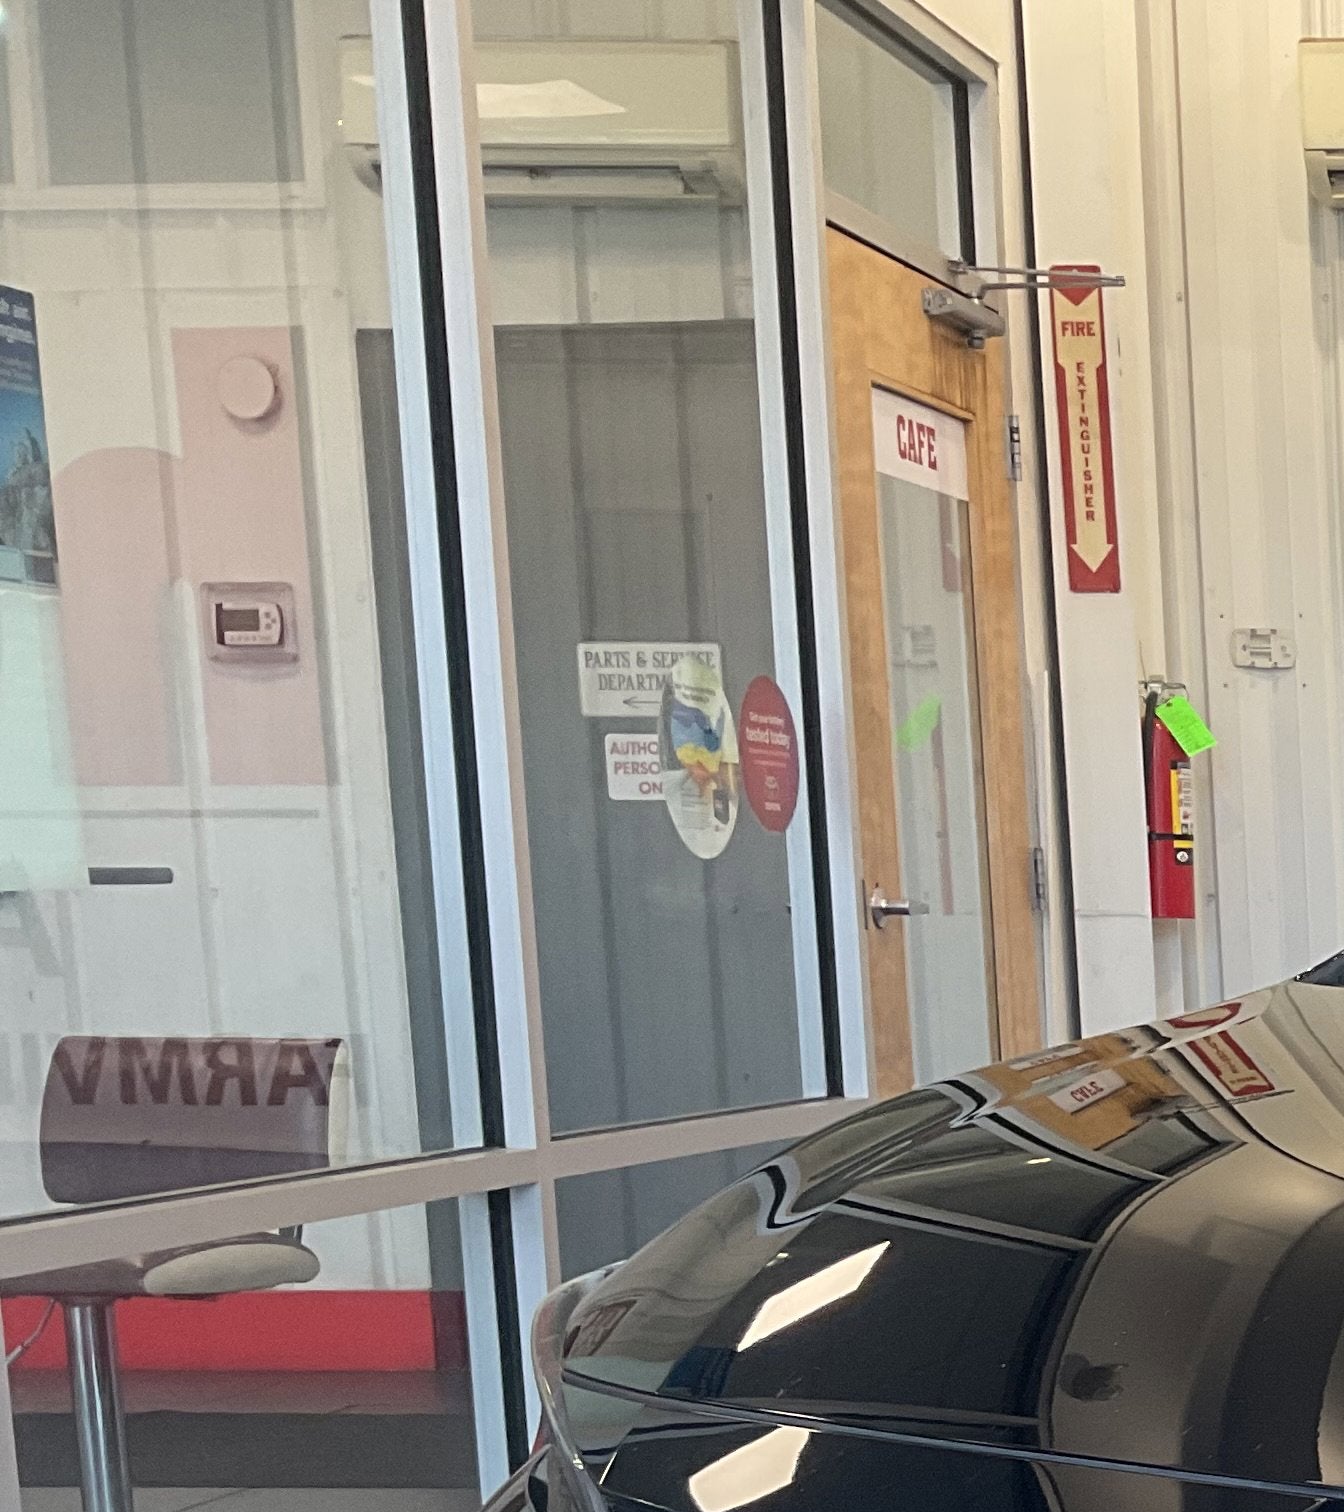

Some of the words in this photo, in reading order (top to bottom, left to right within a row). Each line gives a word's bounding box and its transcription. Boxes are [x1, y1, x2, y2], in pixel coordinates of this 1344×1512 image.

[1061, 321, 1096, 337] FIRE
[896, 414, 938, 471] CAFE
[1075, 361, 1096, 522] EXTINGUISHER
[583, 650, 631, 669] PARTS
[636, 651, 649, 669] &
[597, 672, 671, 692] DEPARTM
[609, 740, 659, 756] AUTHO
[613, 760, 662, 775] PERSO
[638, 781, 664, 796] ON
